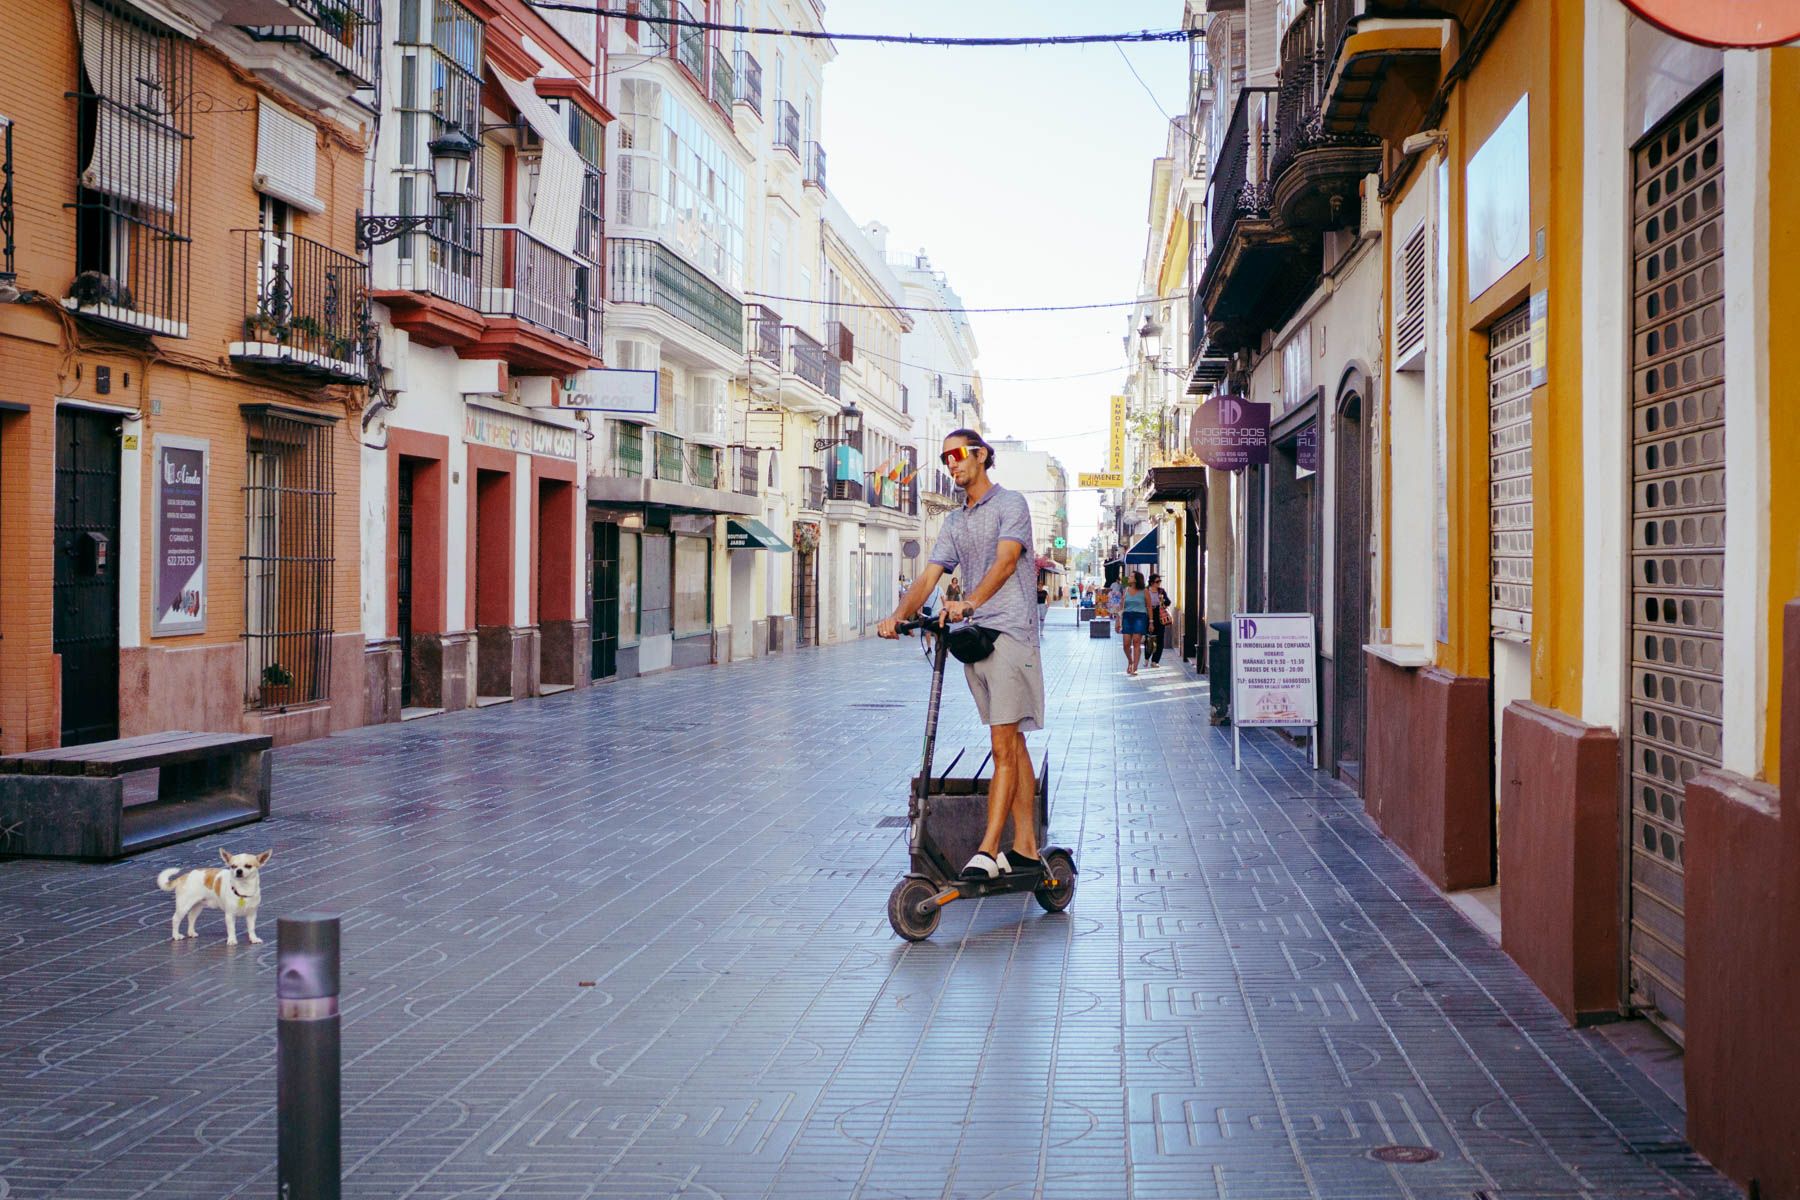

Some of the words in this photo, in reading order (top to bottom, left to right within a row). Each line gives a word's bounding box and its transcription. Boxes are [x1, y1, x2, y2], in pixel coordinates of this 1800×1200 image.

[567, 393, 595, 405] LOW
[1219, 399, 1242, 425] HD
[1195, 427, 1265, 437] HOGAR-DOS
[533, 424, 552, 454] LOW
[554, 430, 576, 458] COST
[1193, 437, 1267, 446] INMOBILIARIA
[1239, 619, 1257, 640] HD
